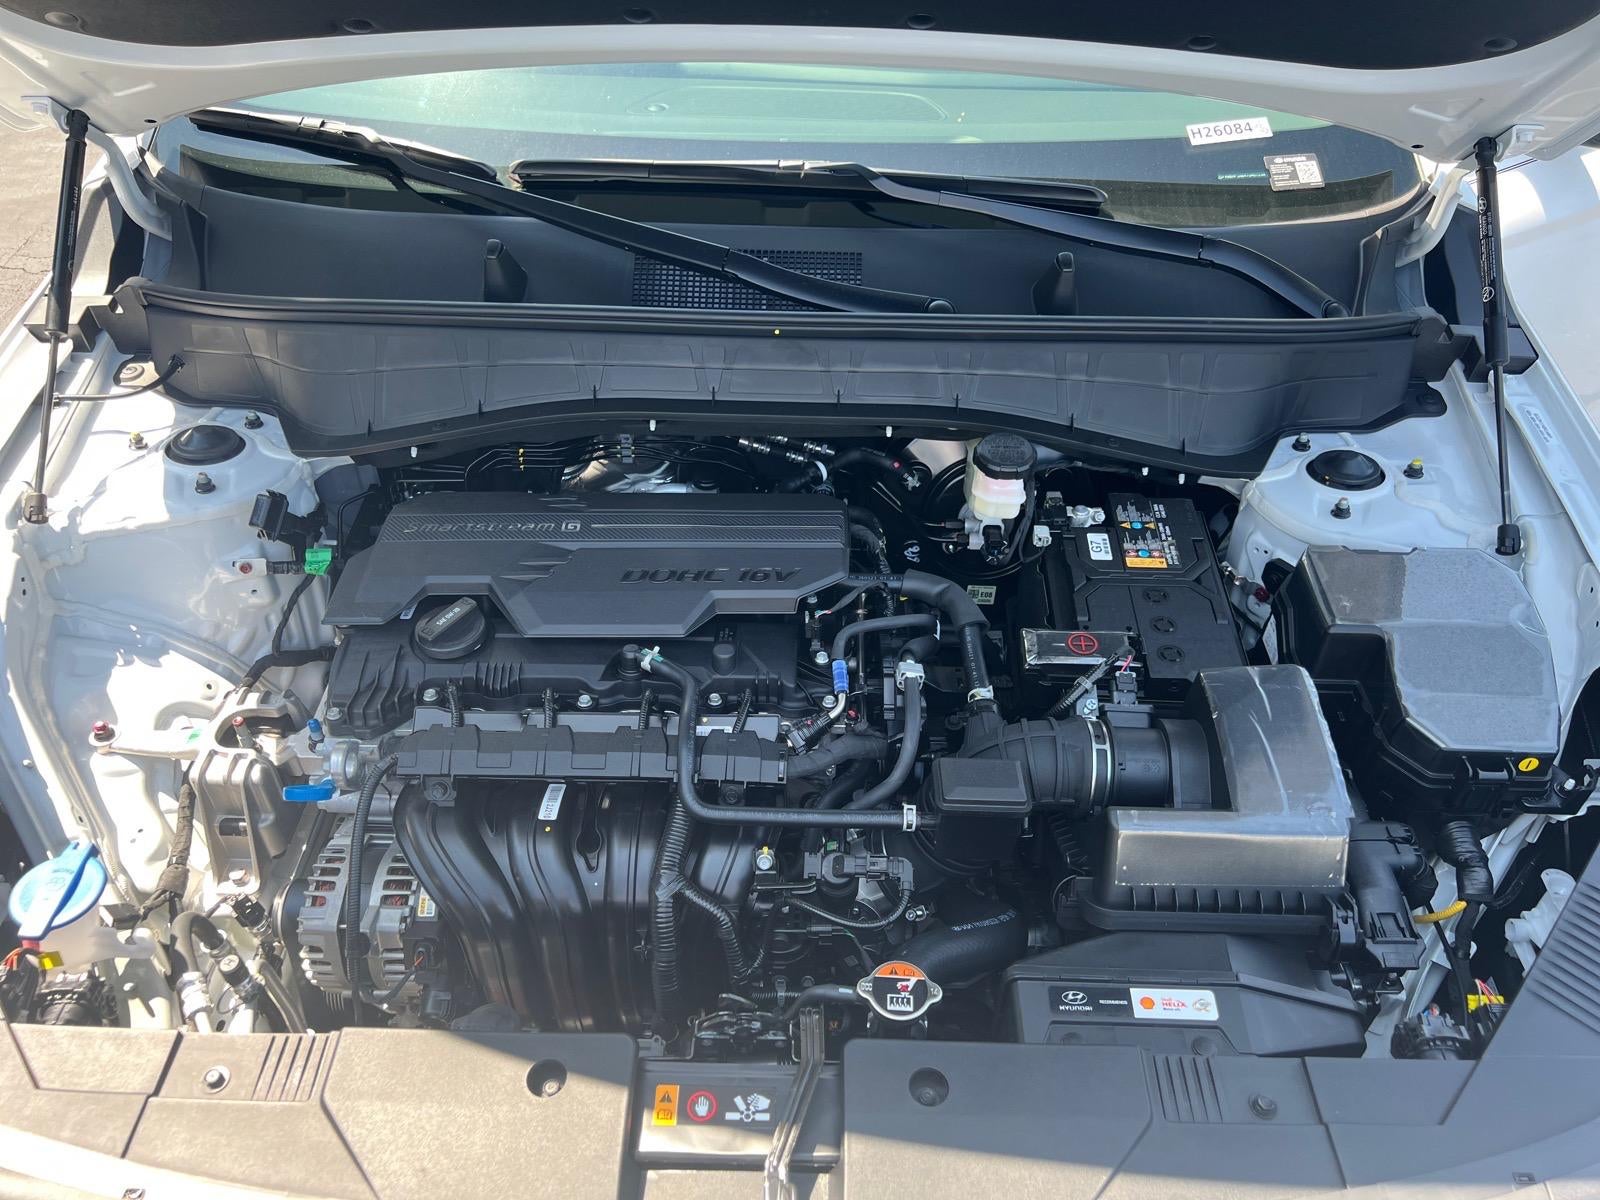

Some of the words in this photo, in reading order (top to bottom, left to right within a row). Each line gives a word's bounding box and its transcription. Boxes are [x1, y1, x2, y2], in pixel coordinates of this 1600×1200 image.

[1191, 121, 1253, 140] H26084
[1091, 540, 1102, 553] G7
[620, 567, 731, 585] DOHC
[737, 567, 802, 584] 16V
[1059, 1004, 1093, 1013] HYUNDAI
[1162, 1000, 1188, 1008] HELIX
